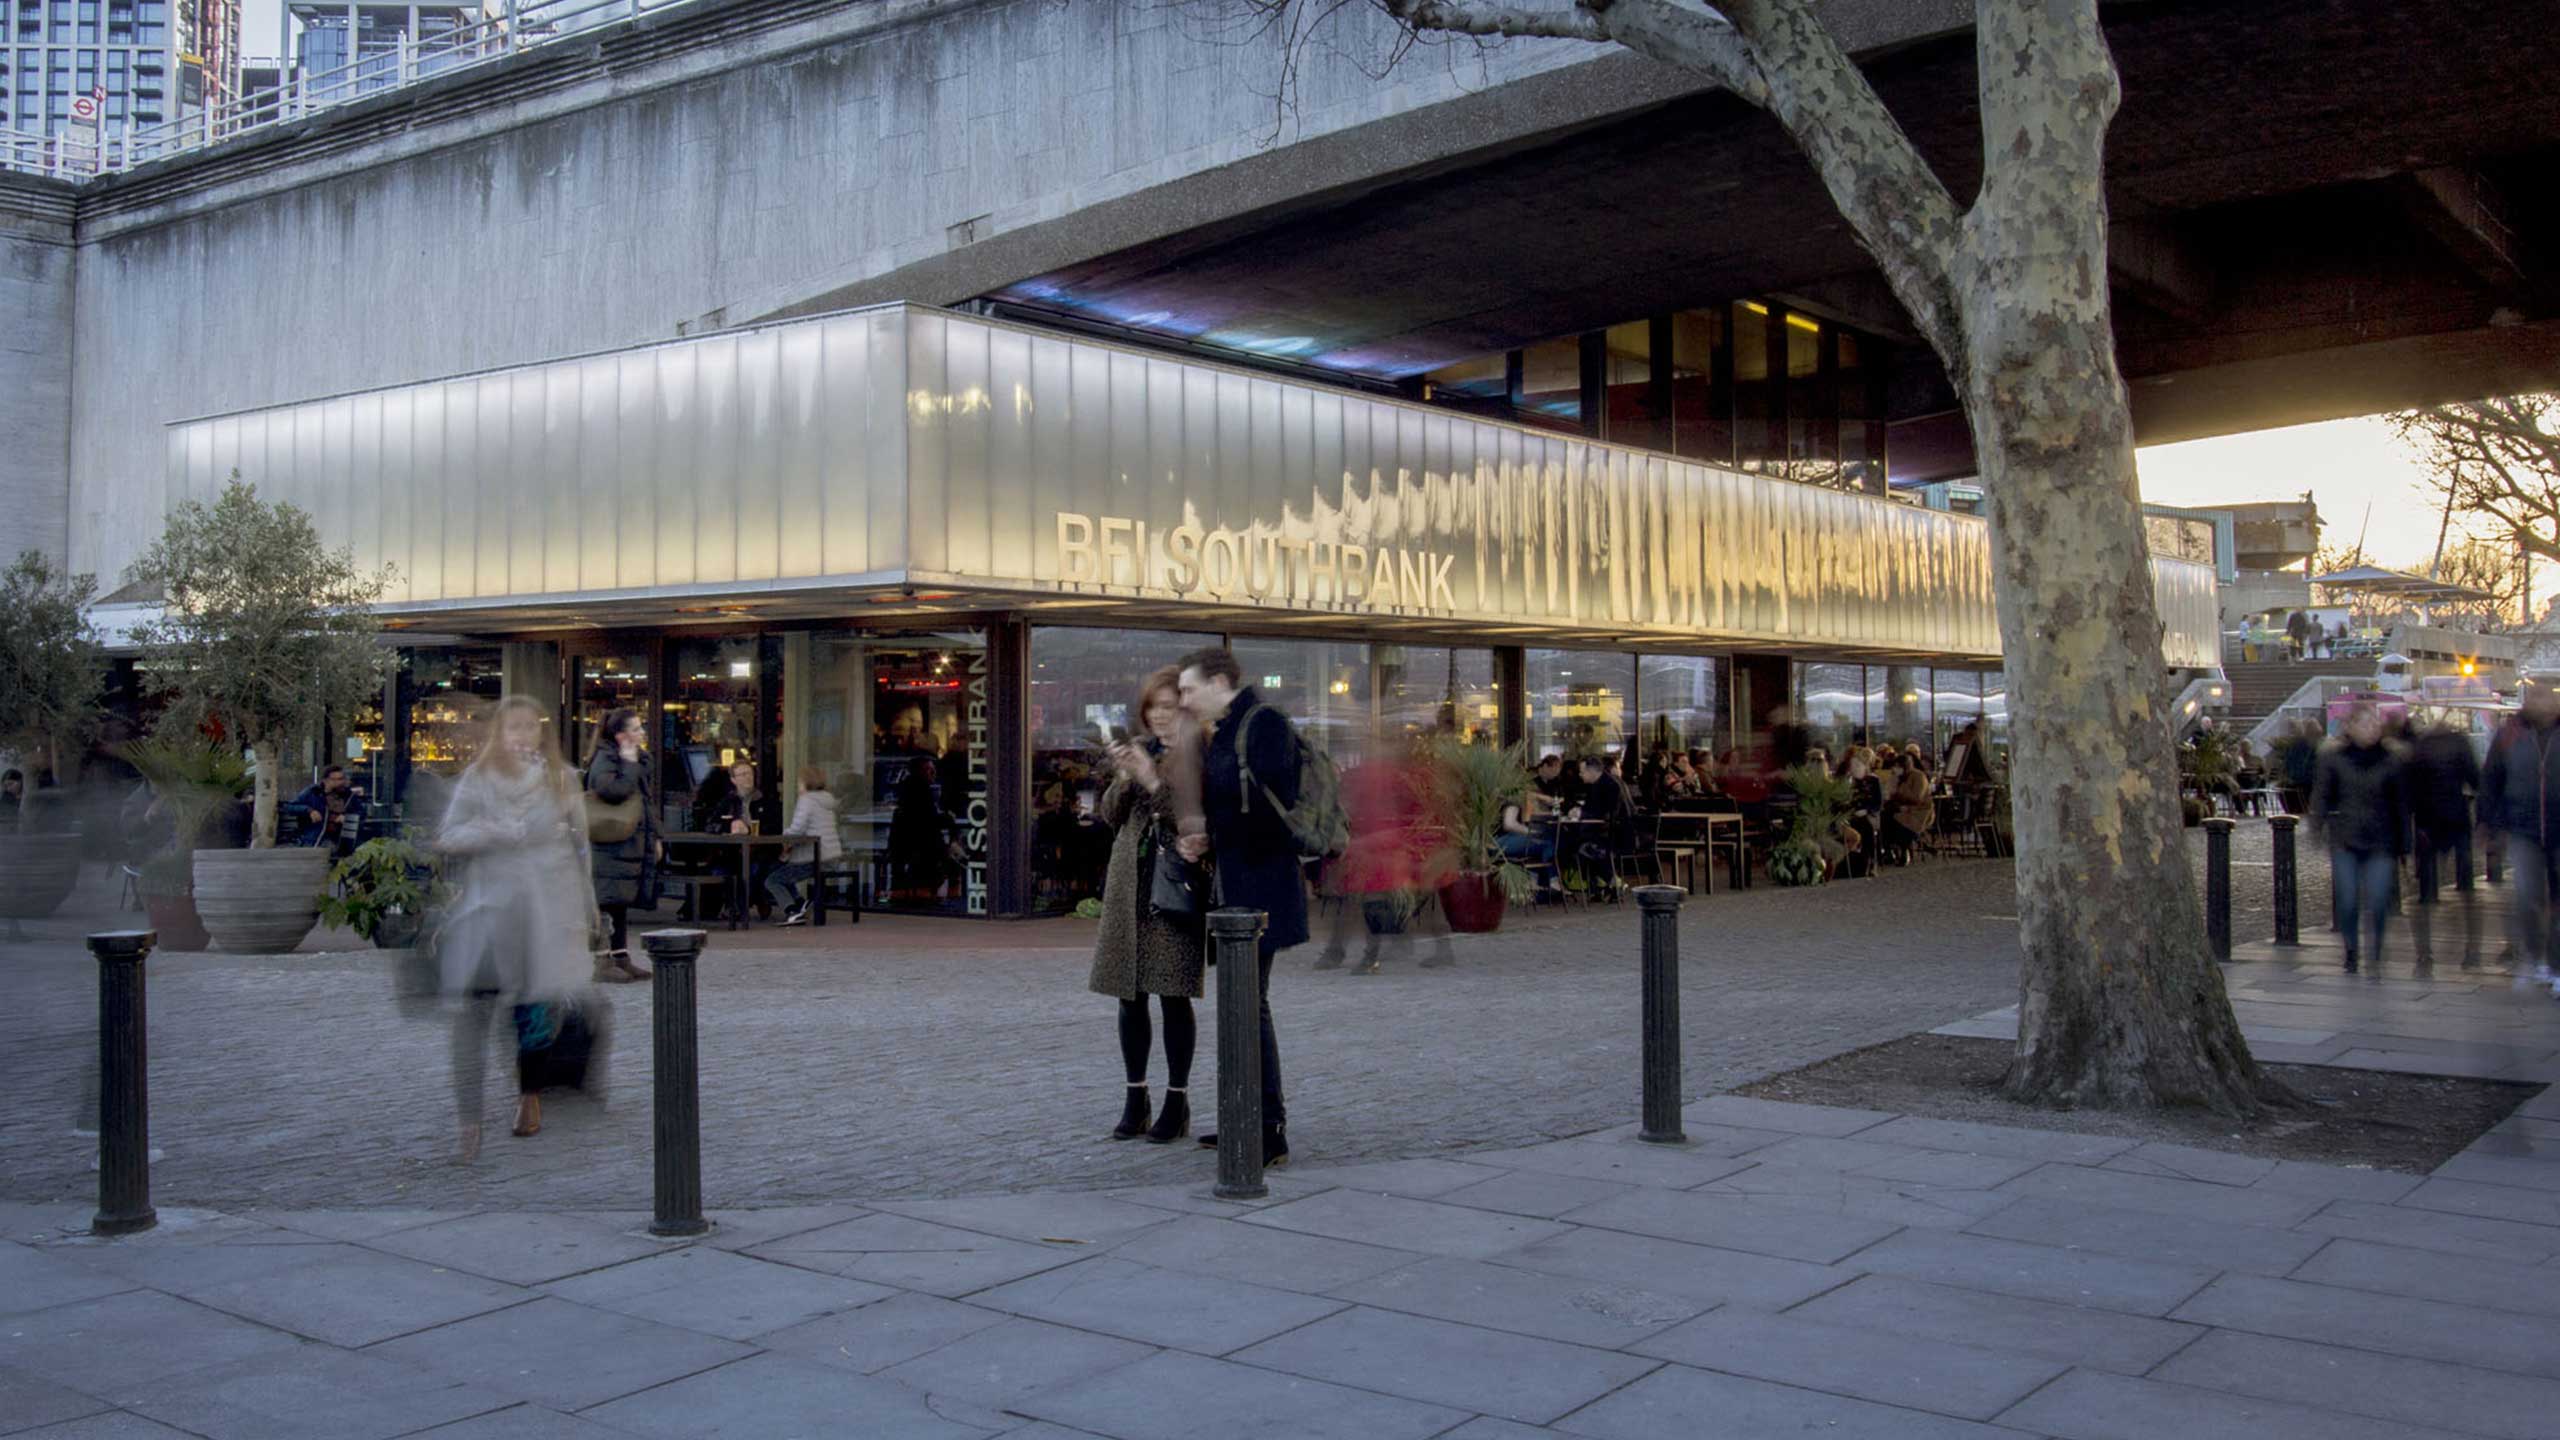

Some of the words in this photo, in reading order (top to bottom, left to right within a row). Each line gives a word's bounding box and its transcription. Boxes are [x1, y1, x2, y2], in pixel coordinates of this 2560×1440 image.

[1056, 512, 1146, 588] BFI
[1165, 525, 1456, 610] SOUTHBANK
[967, 624, 988, 853] SOUTHBANK
[967, 861, 988, 916] BFI
